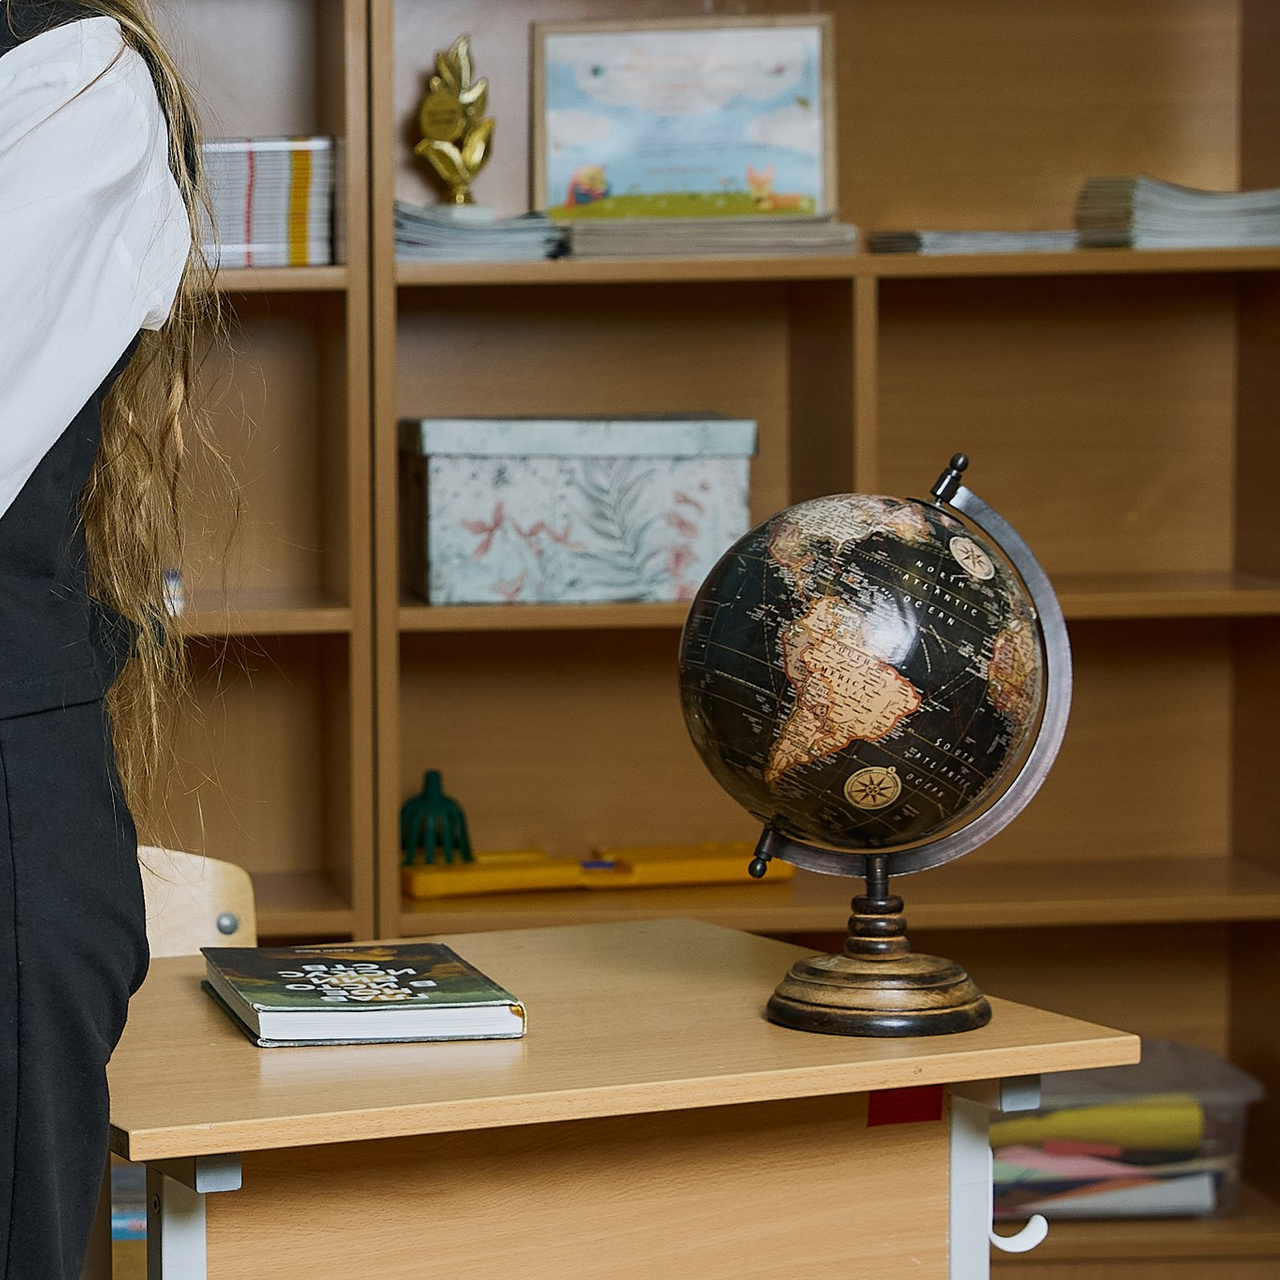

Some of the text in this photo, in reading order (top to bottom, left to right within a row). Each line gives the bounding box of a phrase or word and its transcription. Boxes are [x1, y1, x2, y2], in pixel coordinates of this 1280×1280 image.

[915, 560, 965, 588] NORTH
[902, 573, 978, 617] ATLANTIC
[903, 595, 955, 626] OCEAN
[934, 738, 975, 763] SOUTH
